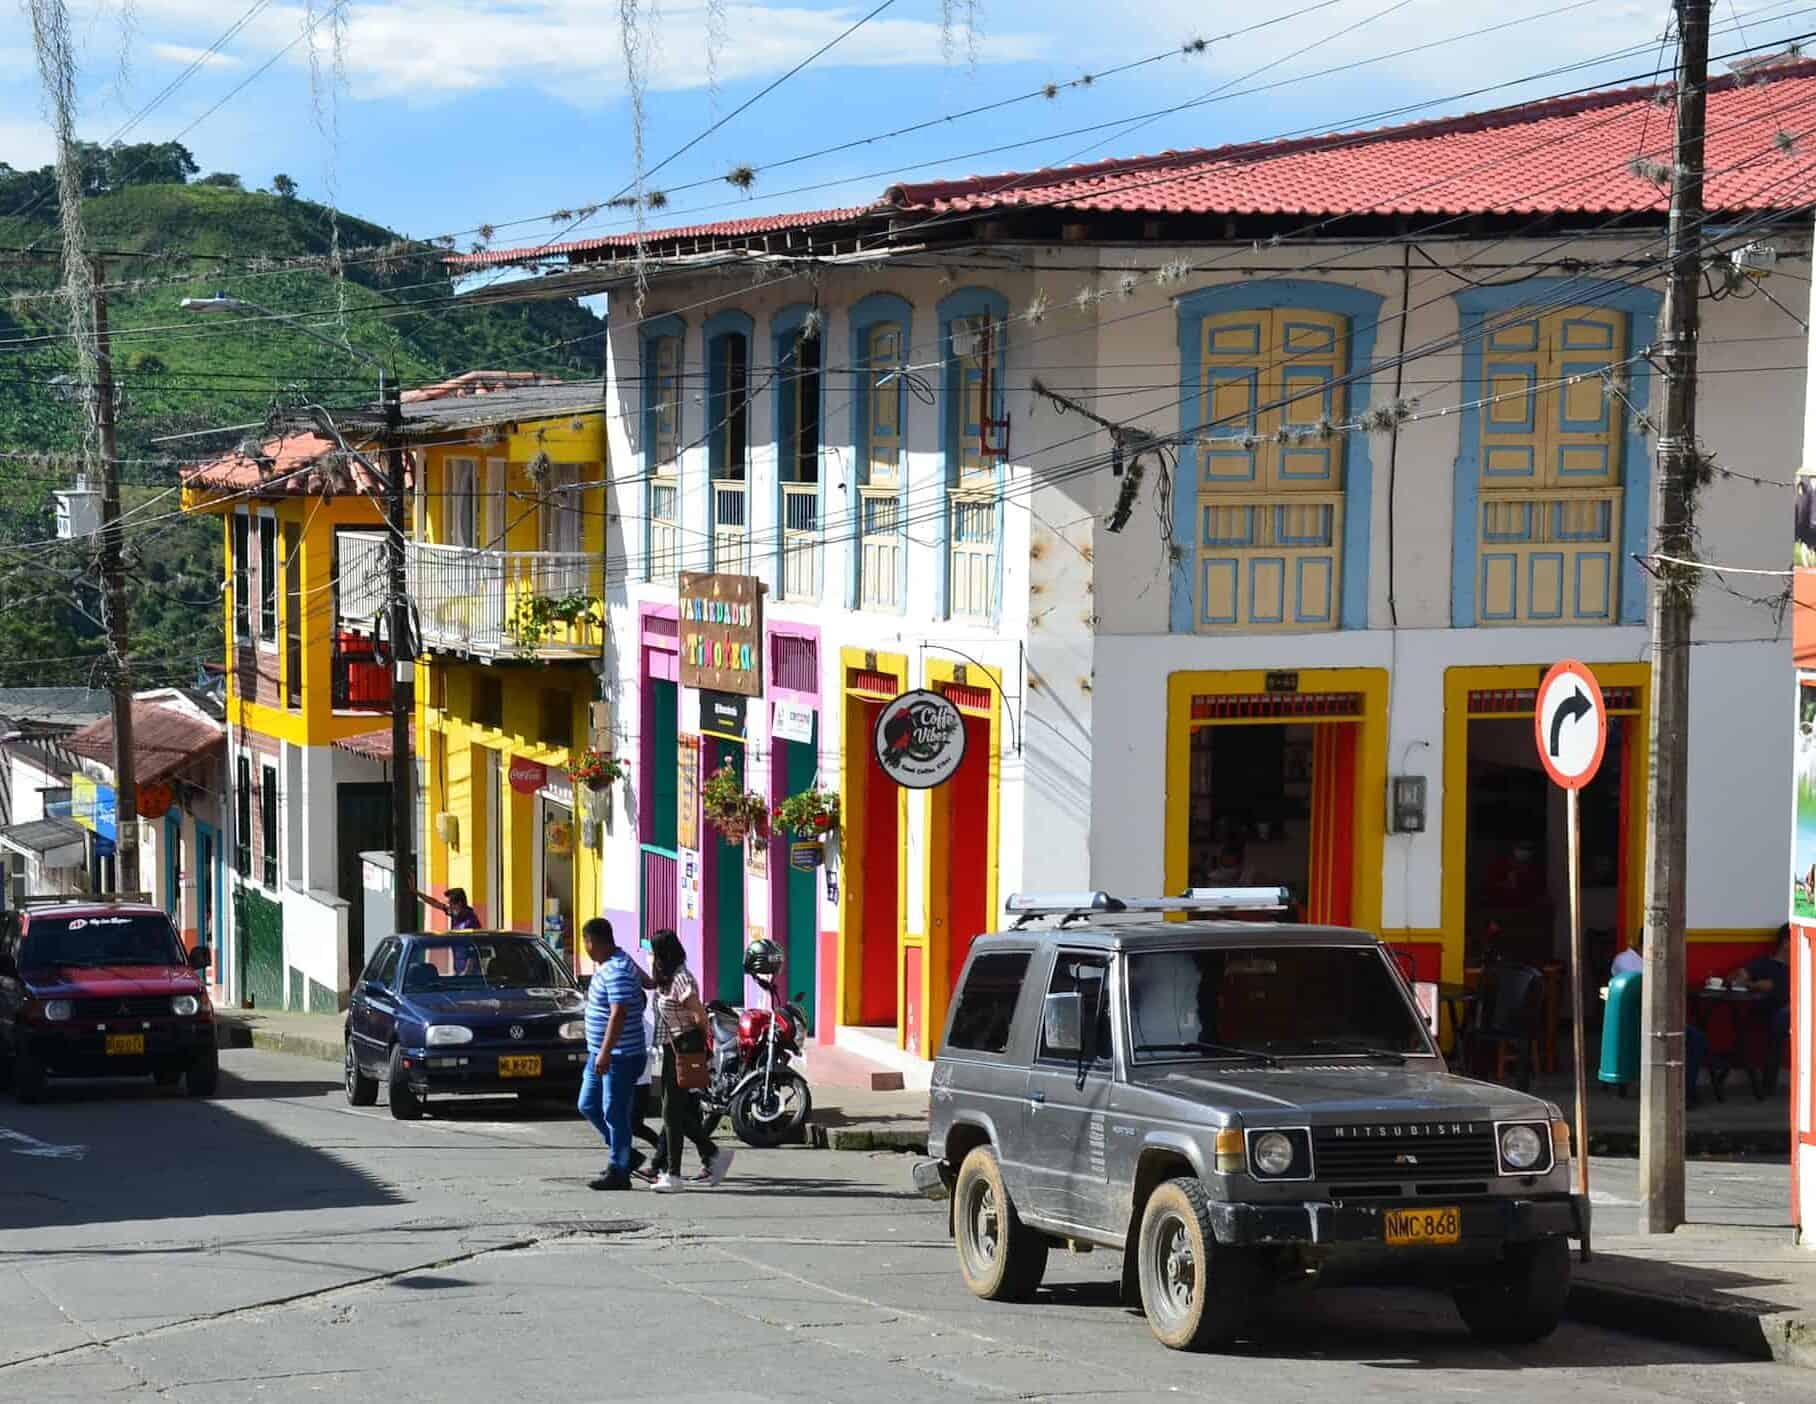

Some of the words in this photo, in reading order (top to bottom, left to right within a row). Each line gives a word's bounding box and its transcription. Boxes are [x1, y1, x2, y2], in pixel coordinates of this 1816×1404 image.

[680, 598, 752, 627] VARIEDADES
[1335, 1123, 1473, 1137] MITSUBISHI
[1387, 1215, 1423, 1238] NMC
[1424, 1214, 1457, 1236] 868
